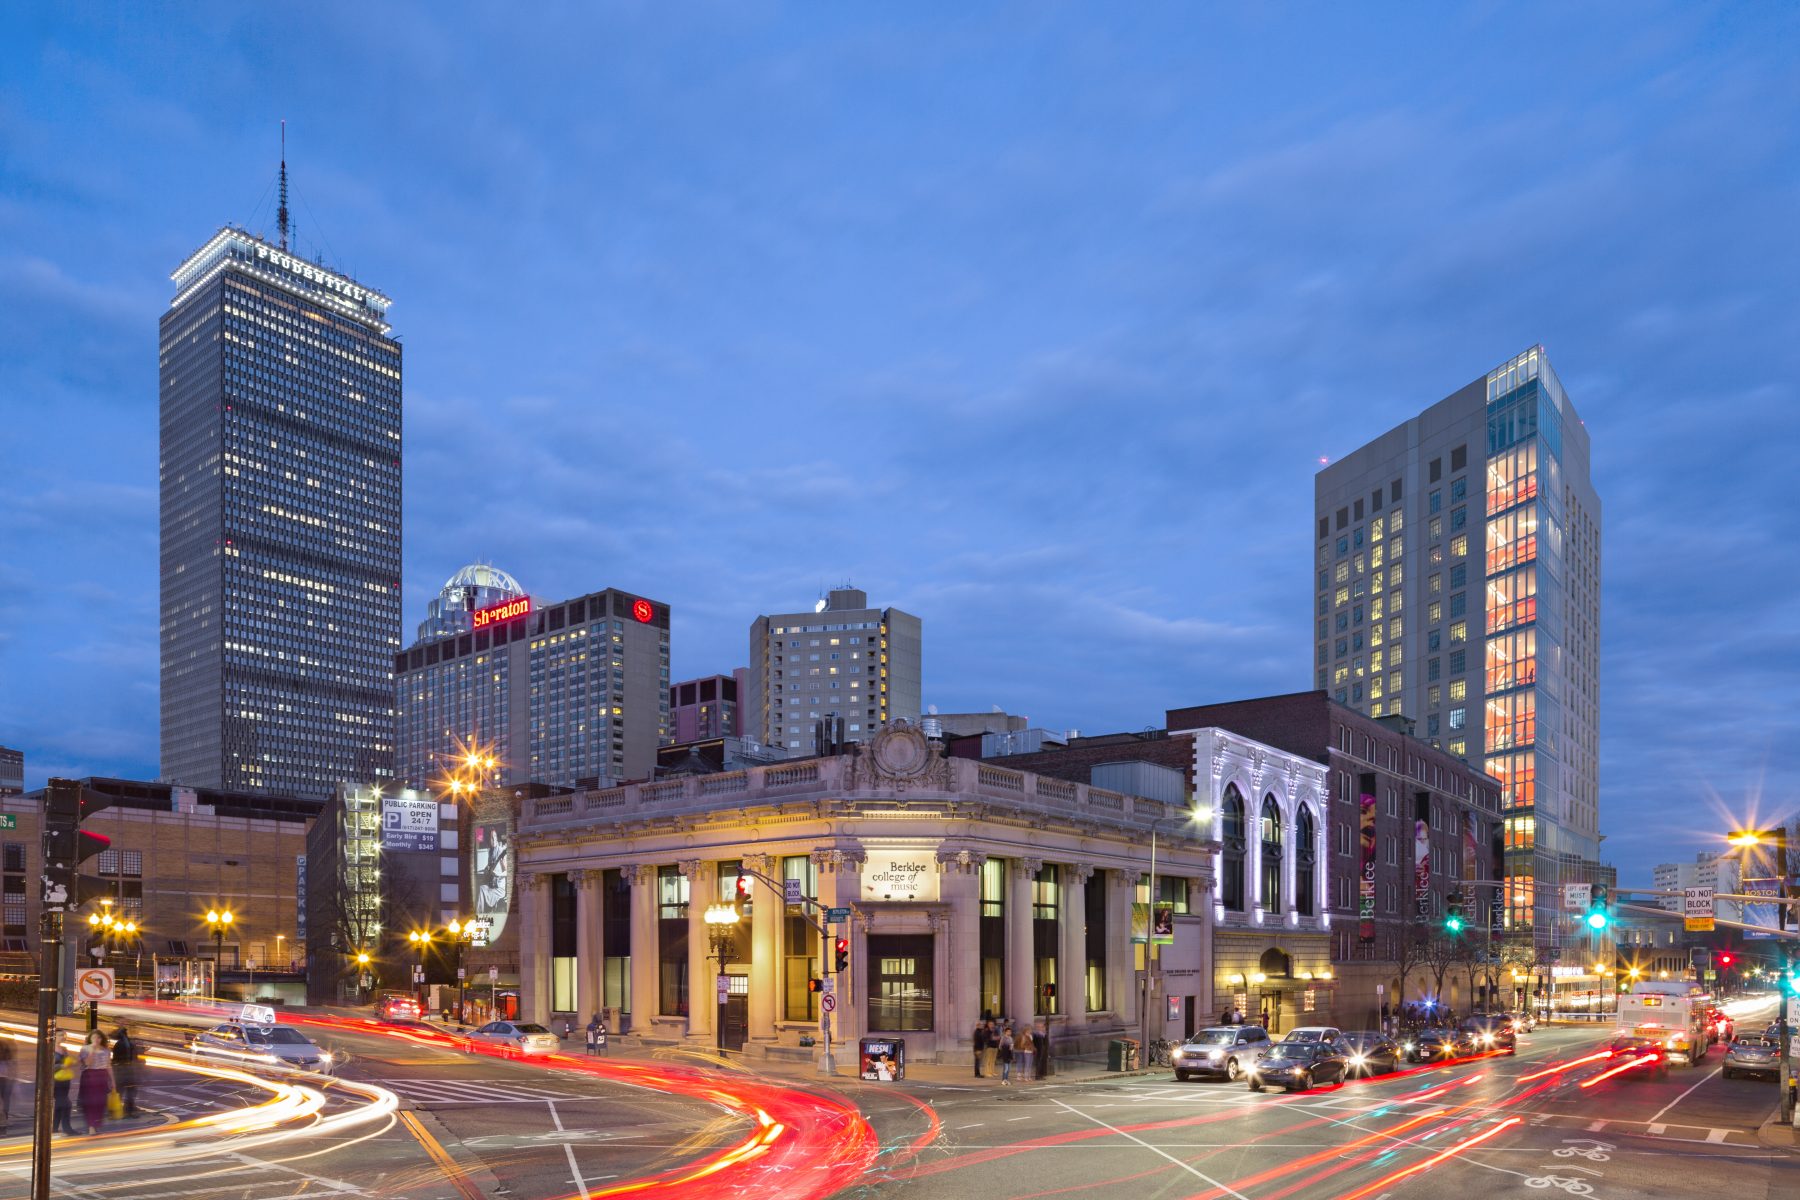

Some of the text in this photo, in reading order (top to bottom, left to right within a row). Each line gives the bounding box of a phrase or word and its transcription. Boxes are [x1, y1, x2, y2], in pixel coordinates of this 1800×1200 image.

[258, 247, 363, 301] PRUDENTIAL
[474, 600, 528, 627] Sheraton
[384, 800, 437, 810] PUBLIC PARKING
[386, 841, 412, 849] Monthly
[890, 862, 927, 872] Berklee
[872, 871, 918, 884] college of
[298, 867, 306, 908] PARK
[1360, 861, 1375, 919] Berklee
[1686, 890, 1712, 898] DO NOT
[1745, 889, 1779, 897] BOSTON
[1416, 872, 1429, 923] Berklee
[1688, 900, 1711, 908] BLOCK
[1492, 888, 1504, 931] Berklee
